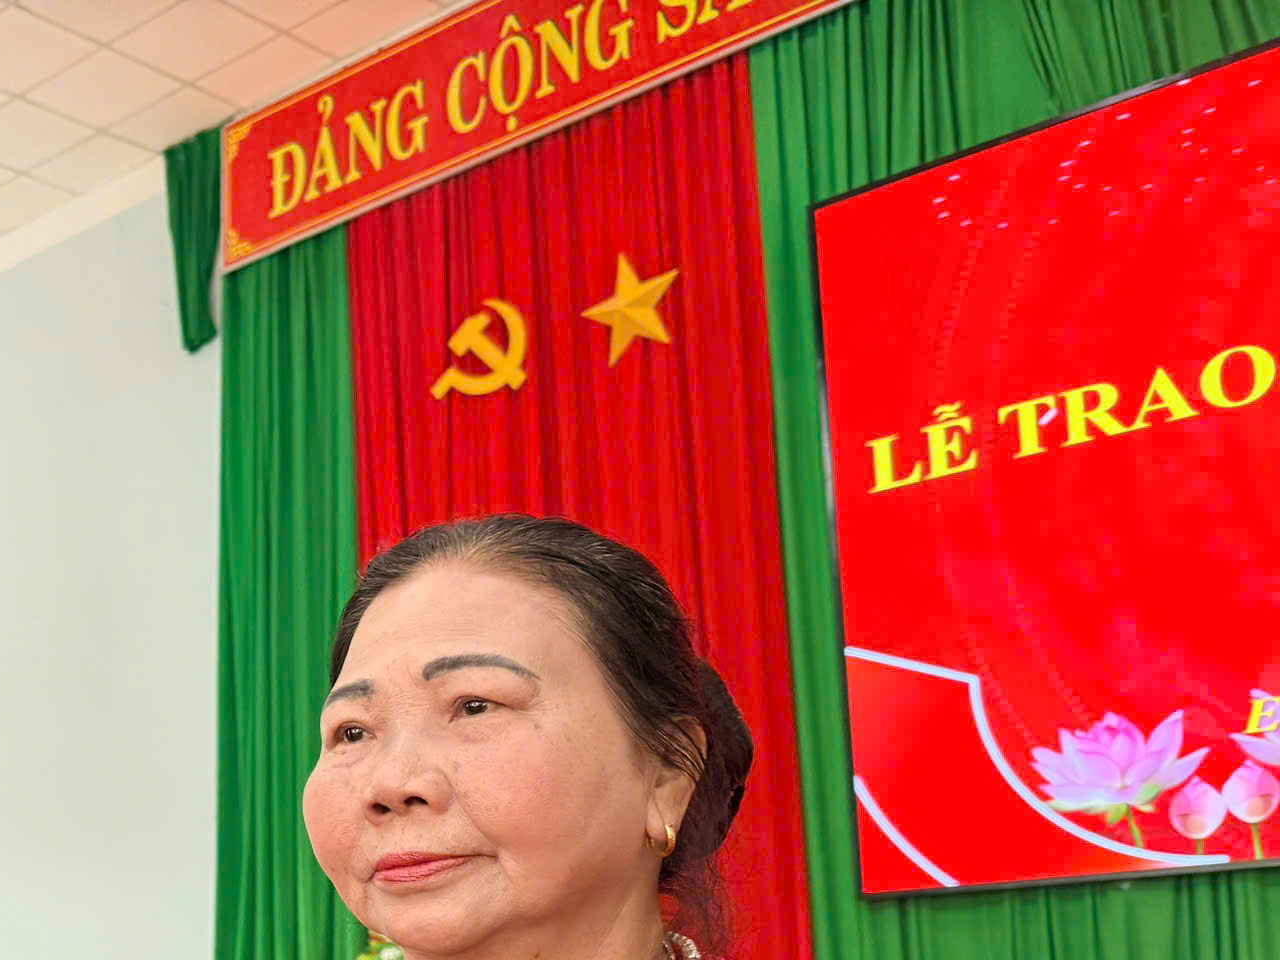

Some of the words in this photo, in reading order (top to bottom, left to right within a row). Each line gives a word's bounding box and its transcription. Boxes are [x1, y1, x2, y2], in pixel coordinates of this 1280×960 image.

[267, 80, 428, 219] ĐẢNG
[446, 0, 634, 133] CỘNG
[865, 402, 980, 494] LỄ
[998, 344, 1277, 459] TRAO
